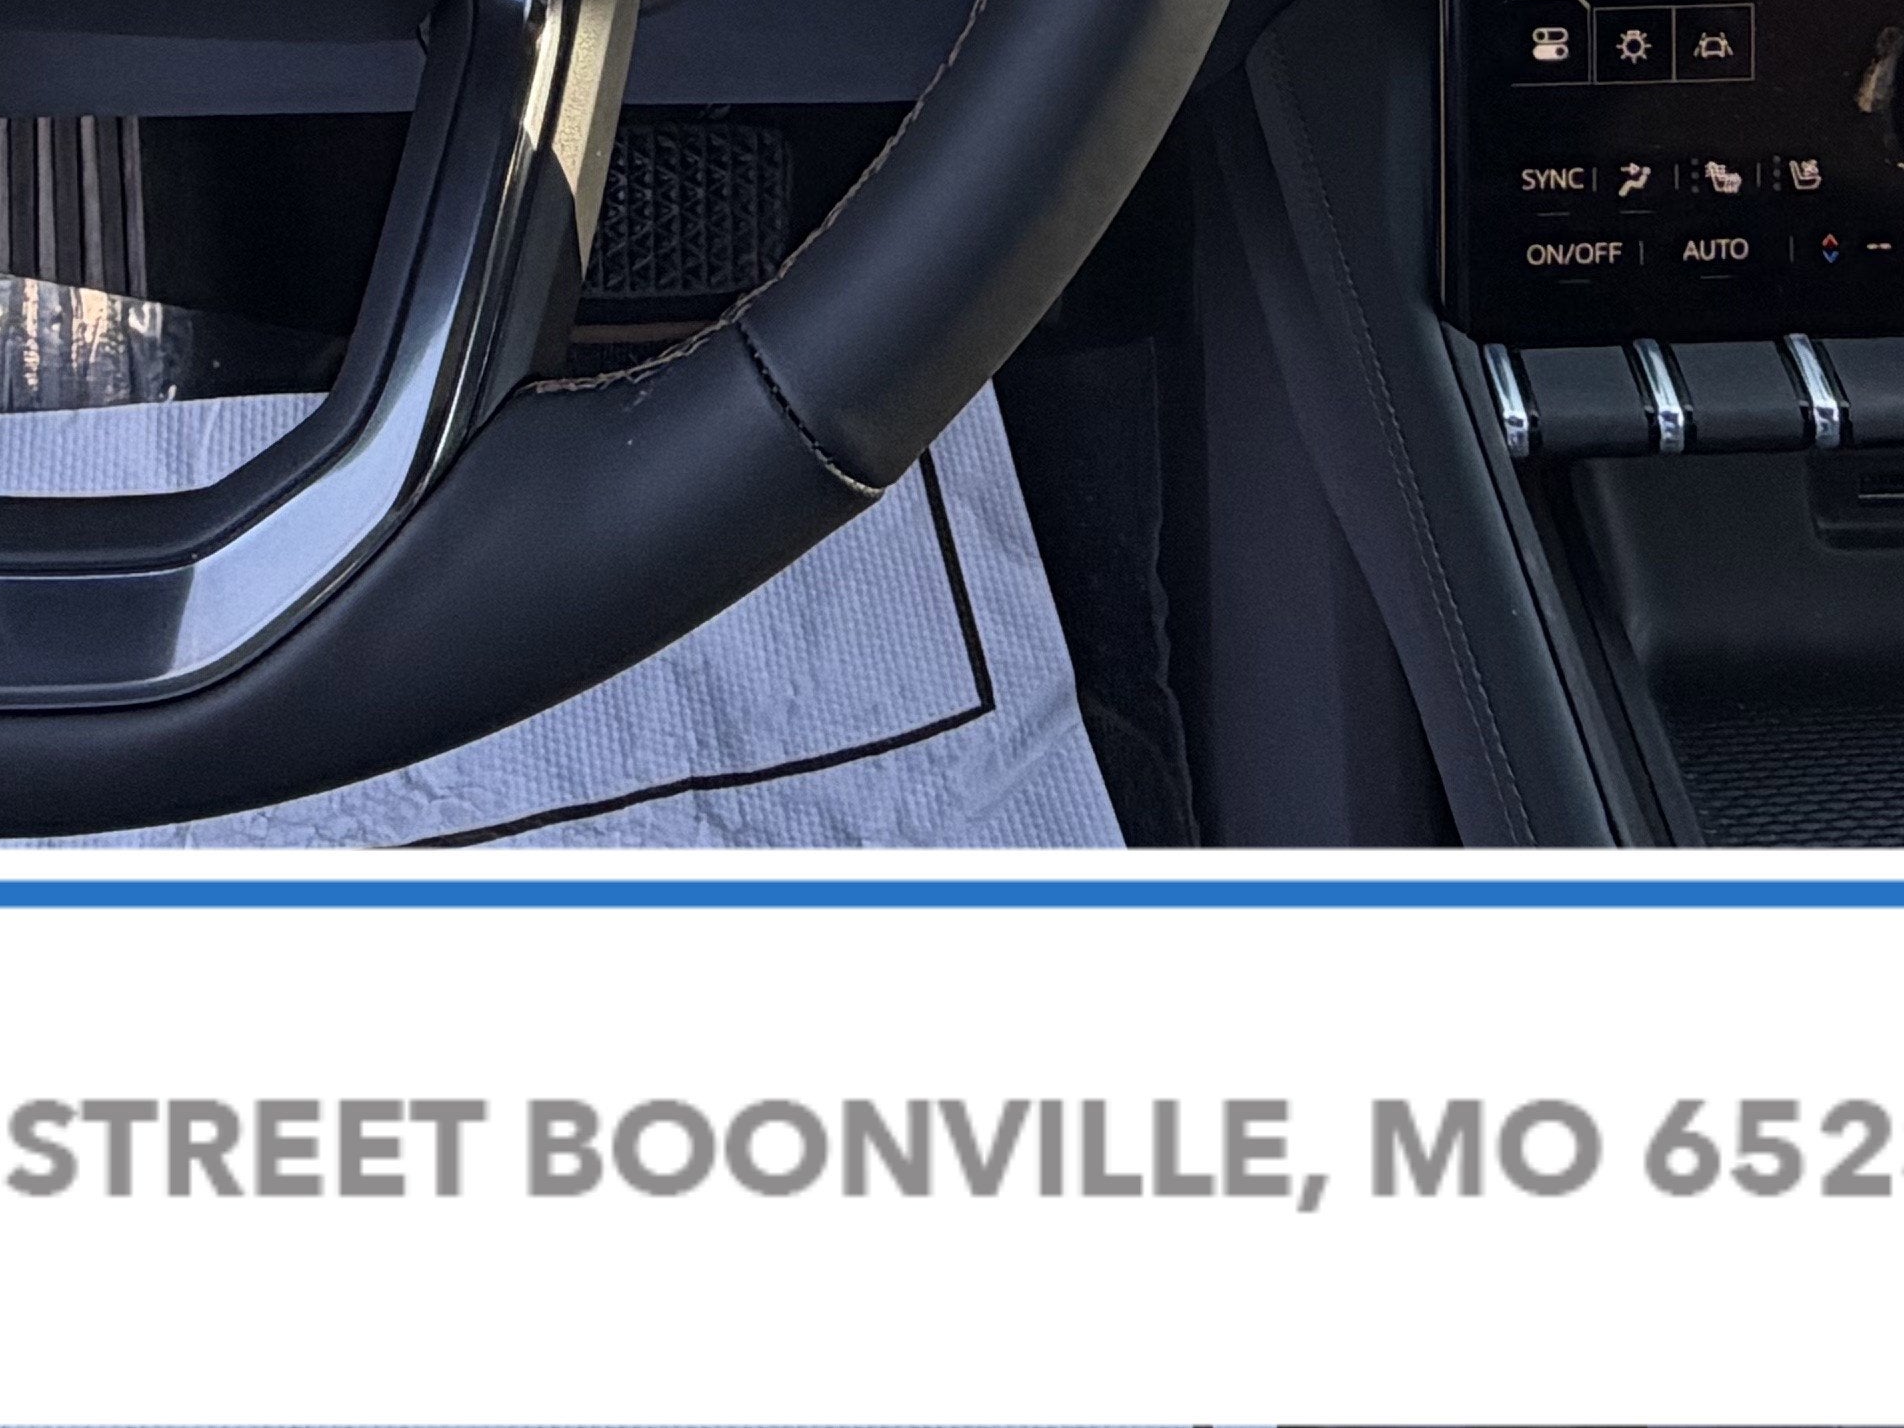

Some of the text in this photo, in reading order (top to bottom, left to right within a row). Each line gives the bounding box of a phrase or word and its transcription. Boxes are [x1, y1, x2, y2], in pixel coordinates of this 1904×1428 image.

[1521, 168, 1585, 191] SYNC
[1526, 242, 1623, 266] ON/OFF
[1682, 239, 1749, 261] AUTO
